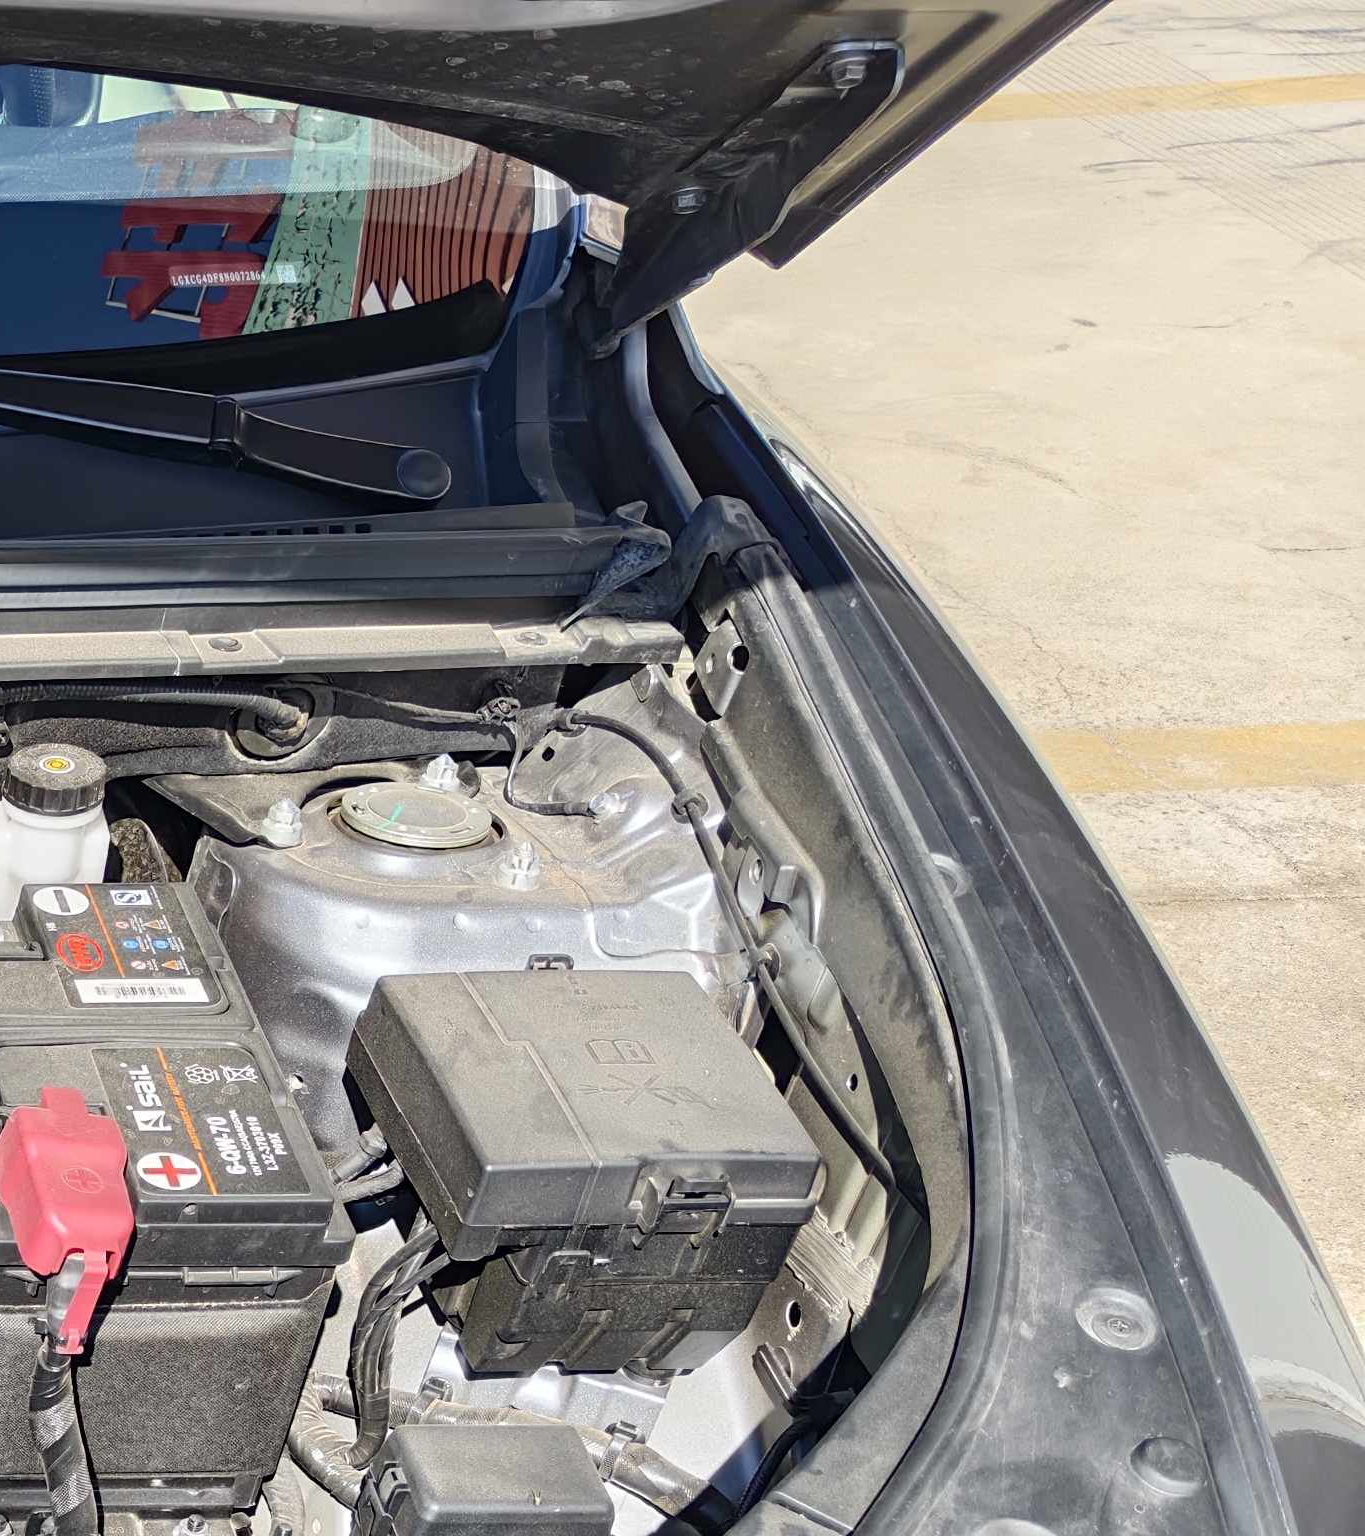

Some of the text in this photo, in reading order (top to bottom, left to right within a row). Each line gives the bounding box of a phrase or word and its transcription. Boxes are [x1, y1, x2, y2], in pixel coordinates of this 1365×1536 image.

[206, 1116, 247, 1175] 6-QW-70
[245, 1116, 279, 1171] L3Z-3703010
[266, 1132, 288, 1155] P09X
